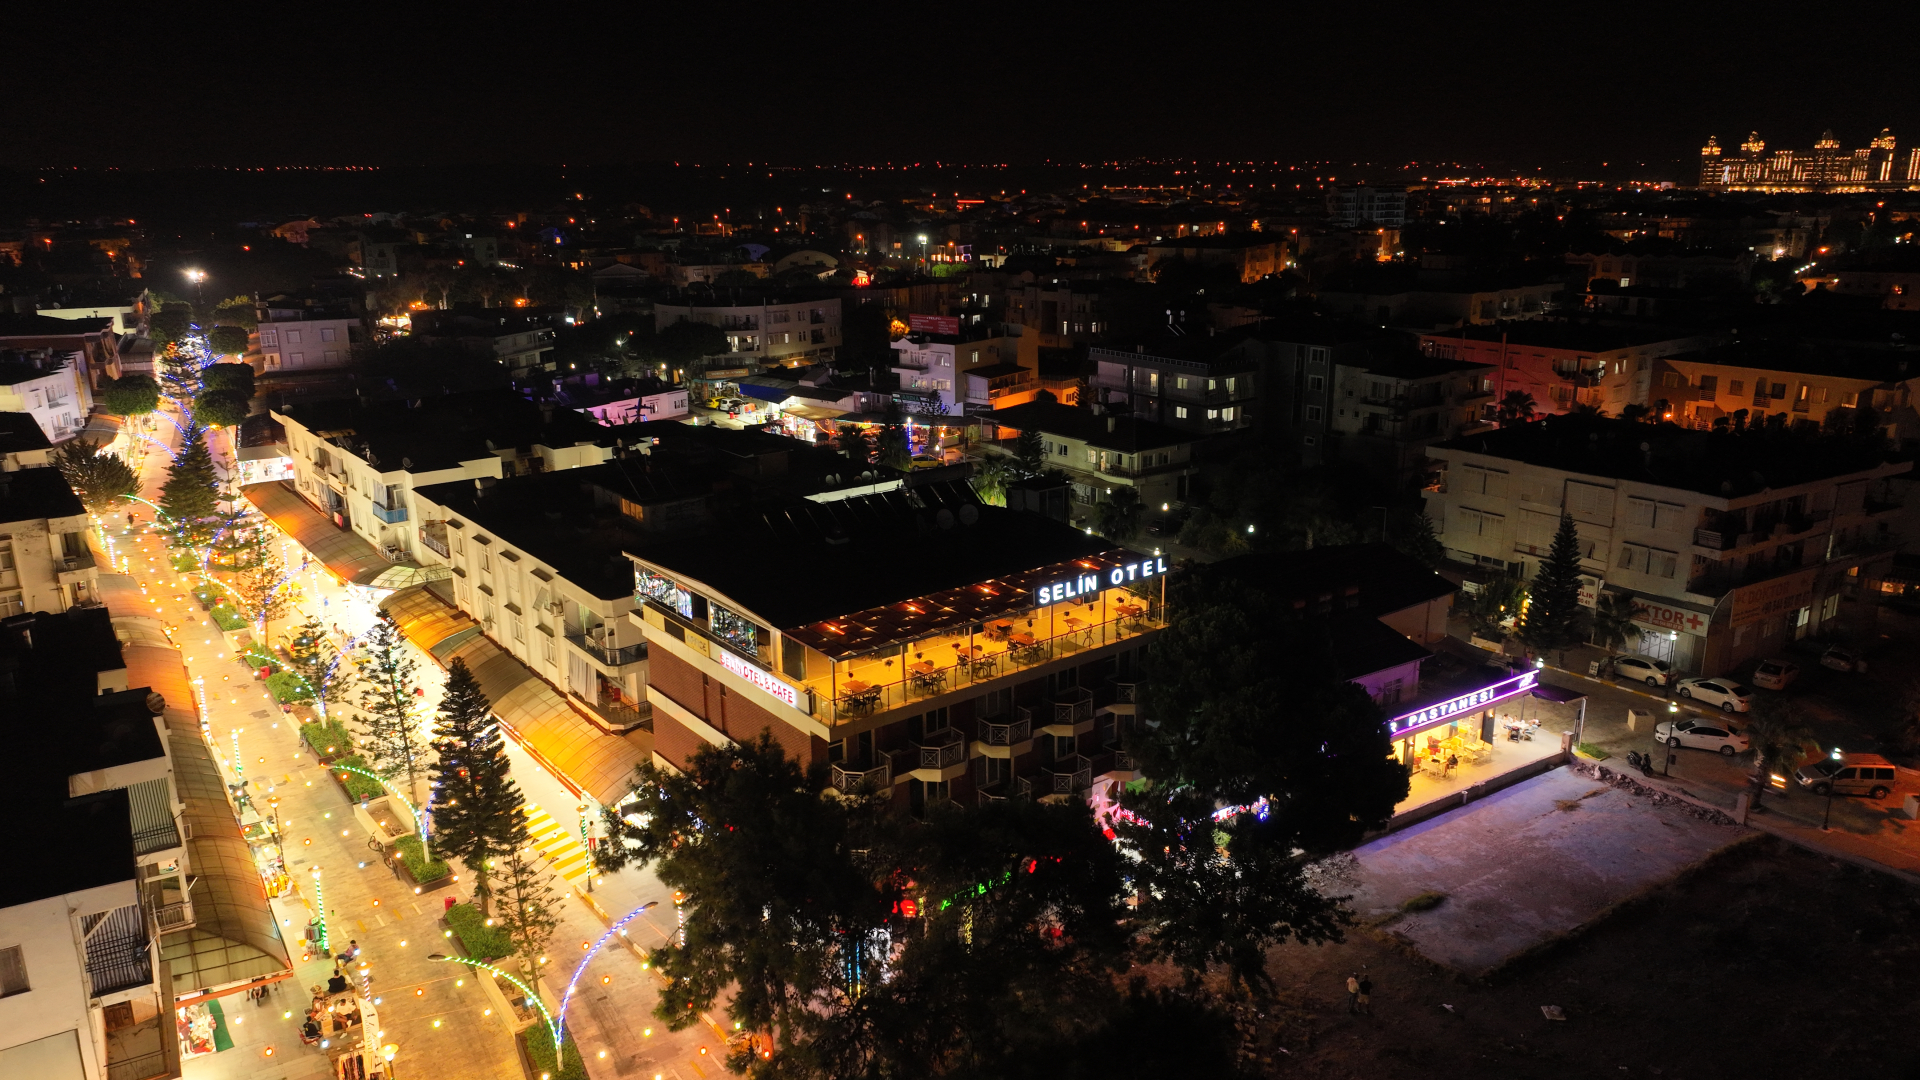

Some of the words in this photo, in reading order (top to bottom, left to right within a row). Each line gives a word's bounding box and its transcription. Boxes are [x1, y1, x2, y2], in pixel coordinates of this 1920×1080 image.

[1038, 575, 1098, 604] SELİN
[1110, 557, 1168, 585] OTEL
[719, 652, 742, 674] SELİN
[743, 666, 764, 687] OTEL
[764, 677, 771, 690] &
[771, 682, 794, 704] CAFE
[1408, 689, 1494, 727] PASTANESİ
